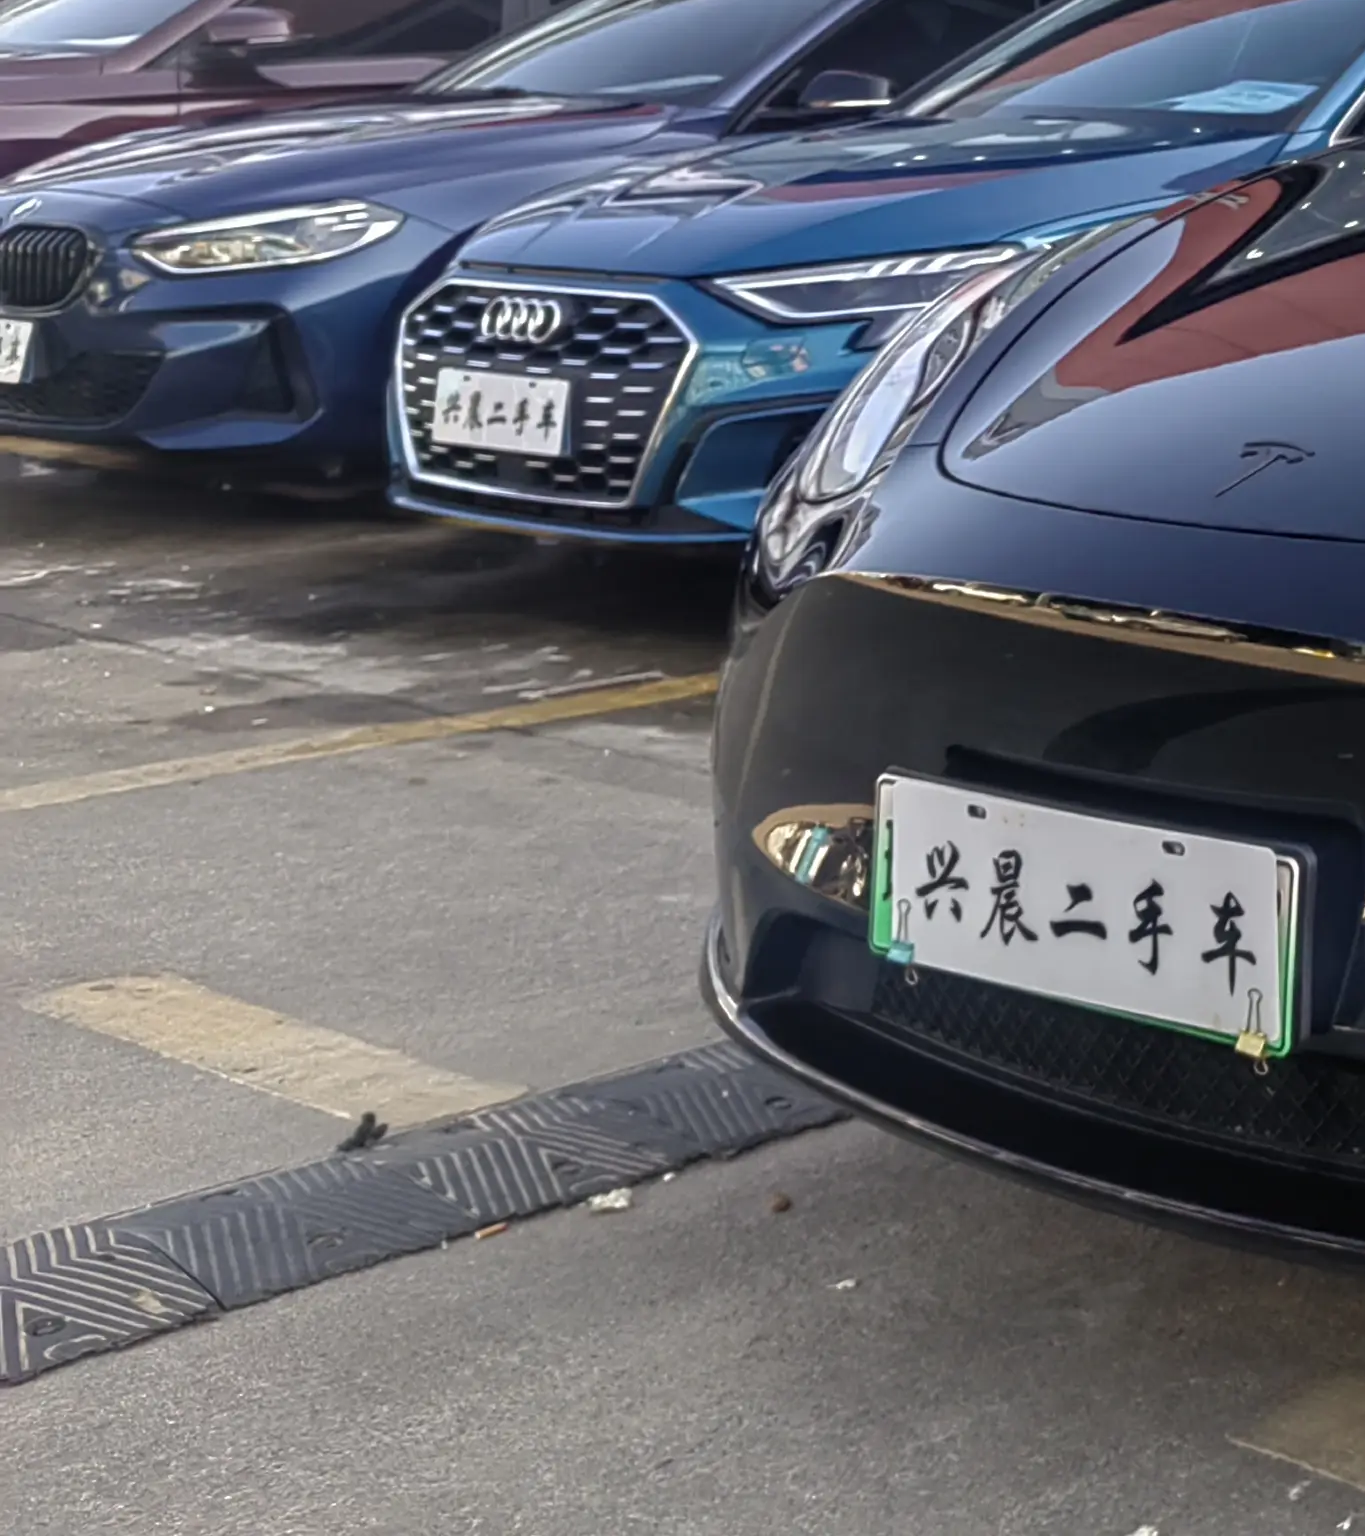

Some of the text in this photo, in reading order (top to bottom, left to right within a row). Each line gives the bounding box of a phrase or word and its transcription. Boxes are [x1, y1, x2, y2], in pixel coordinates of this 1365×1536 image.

[442, 390, 556, 440] 兴晨二手车
[915, 840, 1257, 995] 兴晨二手车
